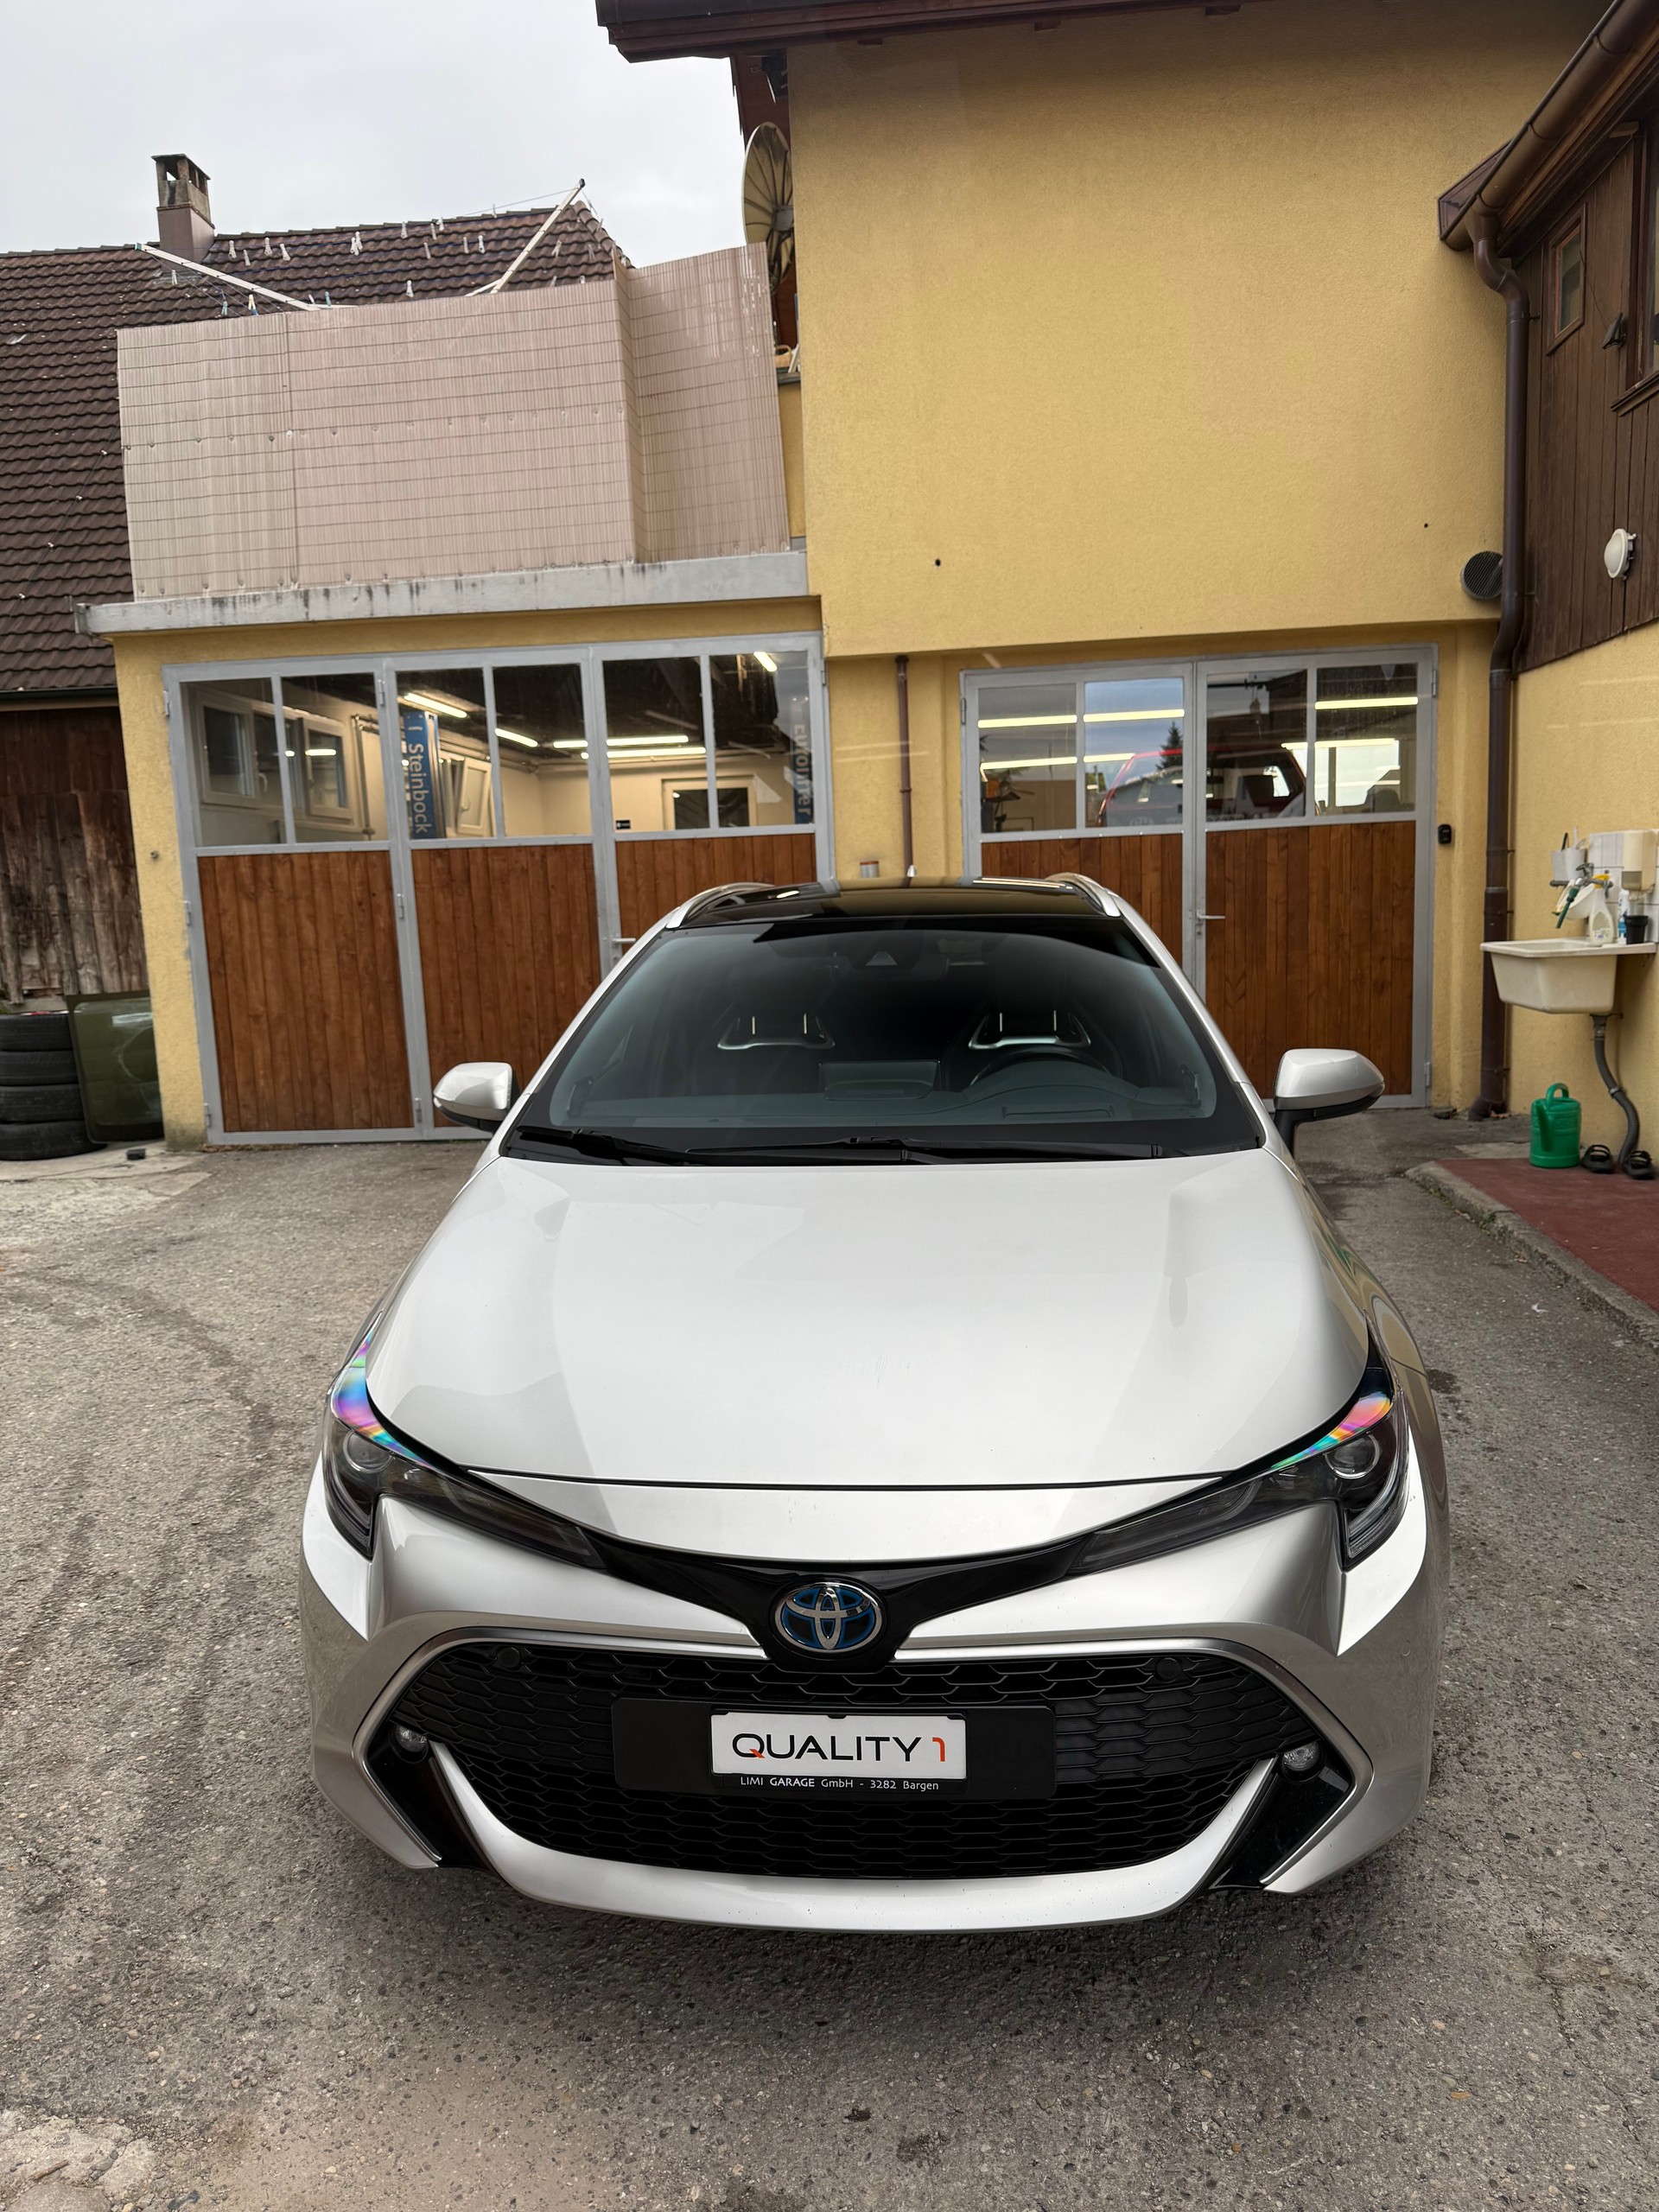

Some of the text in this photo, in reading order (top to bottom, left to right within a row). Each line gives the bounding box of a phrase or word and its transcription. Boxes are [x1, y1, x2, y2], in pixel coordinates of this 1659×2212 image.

[408, 743, 432, 834] Steinbock
[732, 1732, 946, 1763] QUALITY 1
[741, 1777, 763, 1786] LIMI
[770, 1777, 815, 1788] GARAGE
[821, 1778, 854, 1789] GmbH
[870, 1779, 897, 1789] 3282
[903, 1780, 939, 1791] Bargen
